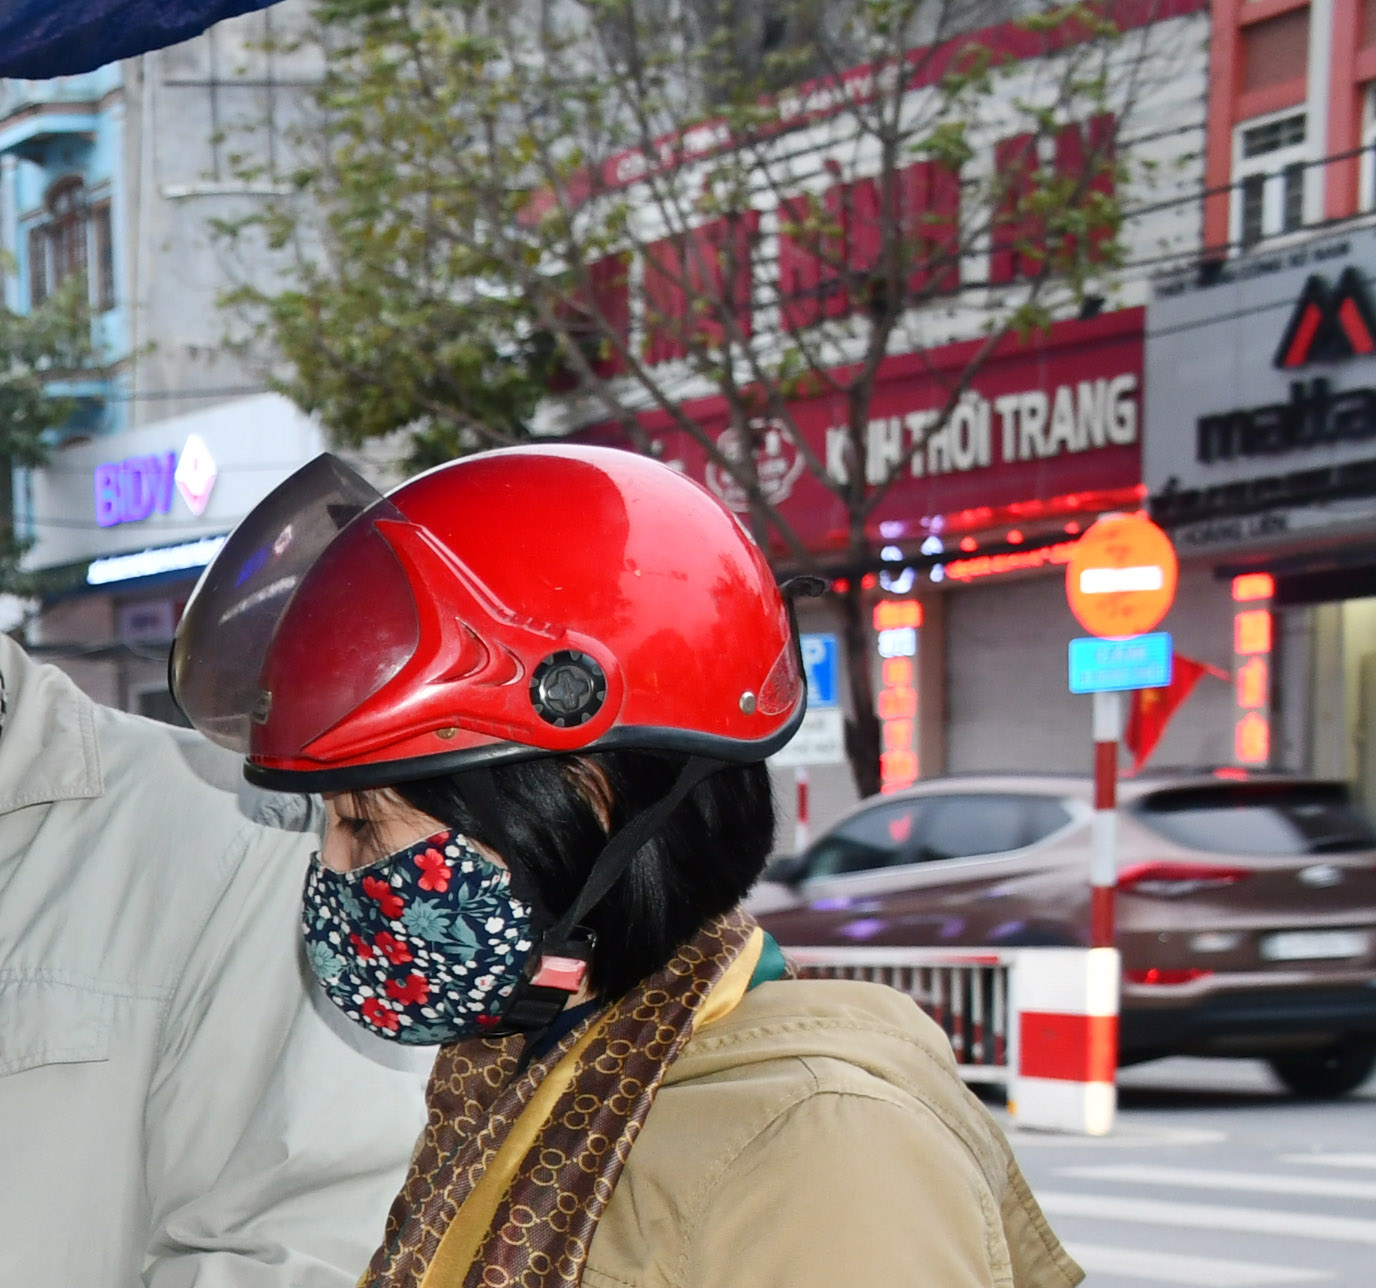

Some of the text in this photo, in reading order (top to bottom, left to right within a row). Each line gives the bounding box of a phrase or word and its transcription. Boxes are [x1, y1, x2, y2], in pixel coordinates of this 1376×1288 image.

[824, 414, 905, 487] KH
[994, 373, 1137, 463] TRANG
[94, 450, 176, 528] BIDV
